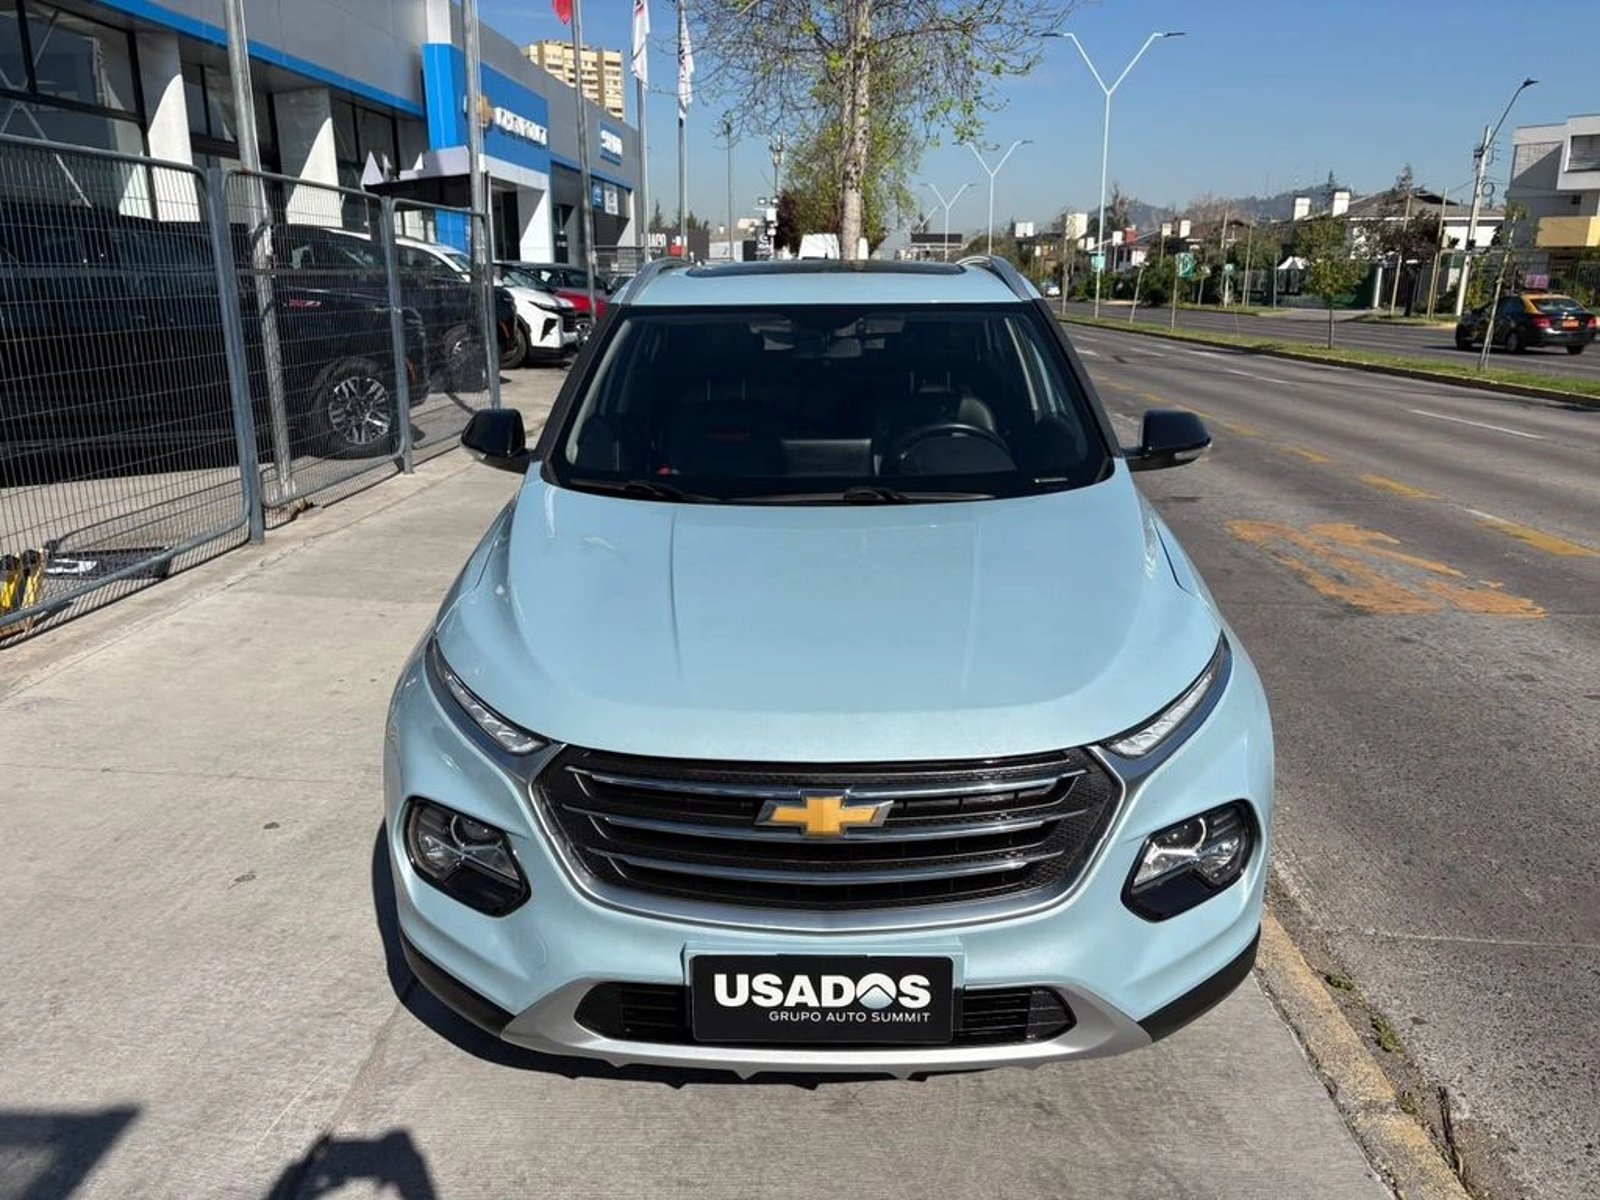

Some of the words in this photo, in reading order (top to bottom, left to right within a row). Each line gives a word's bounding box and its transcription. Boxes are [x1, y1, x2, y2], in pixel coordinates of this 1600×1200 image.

[713, 972, 932, 1009] USADOS
[769, 1010, 821, 1022] GRUPO
[826, 1011, 867, 1023] AUTO
[871, 1011, 931, 1023] SUMMIT
